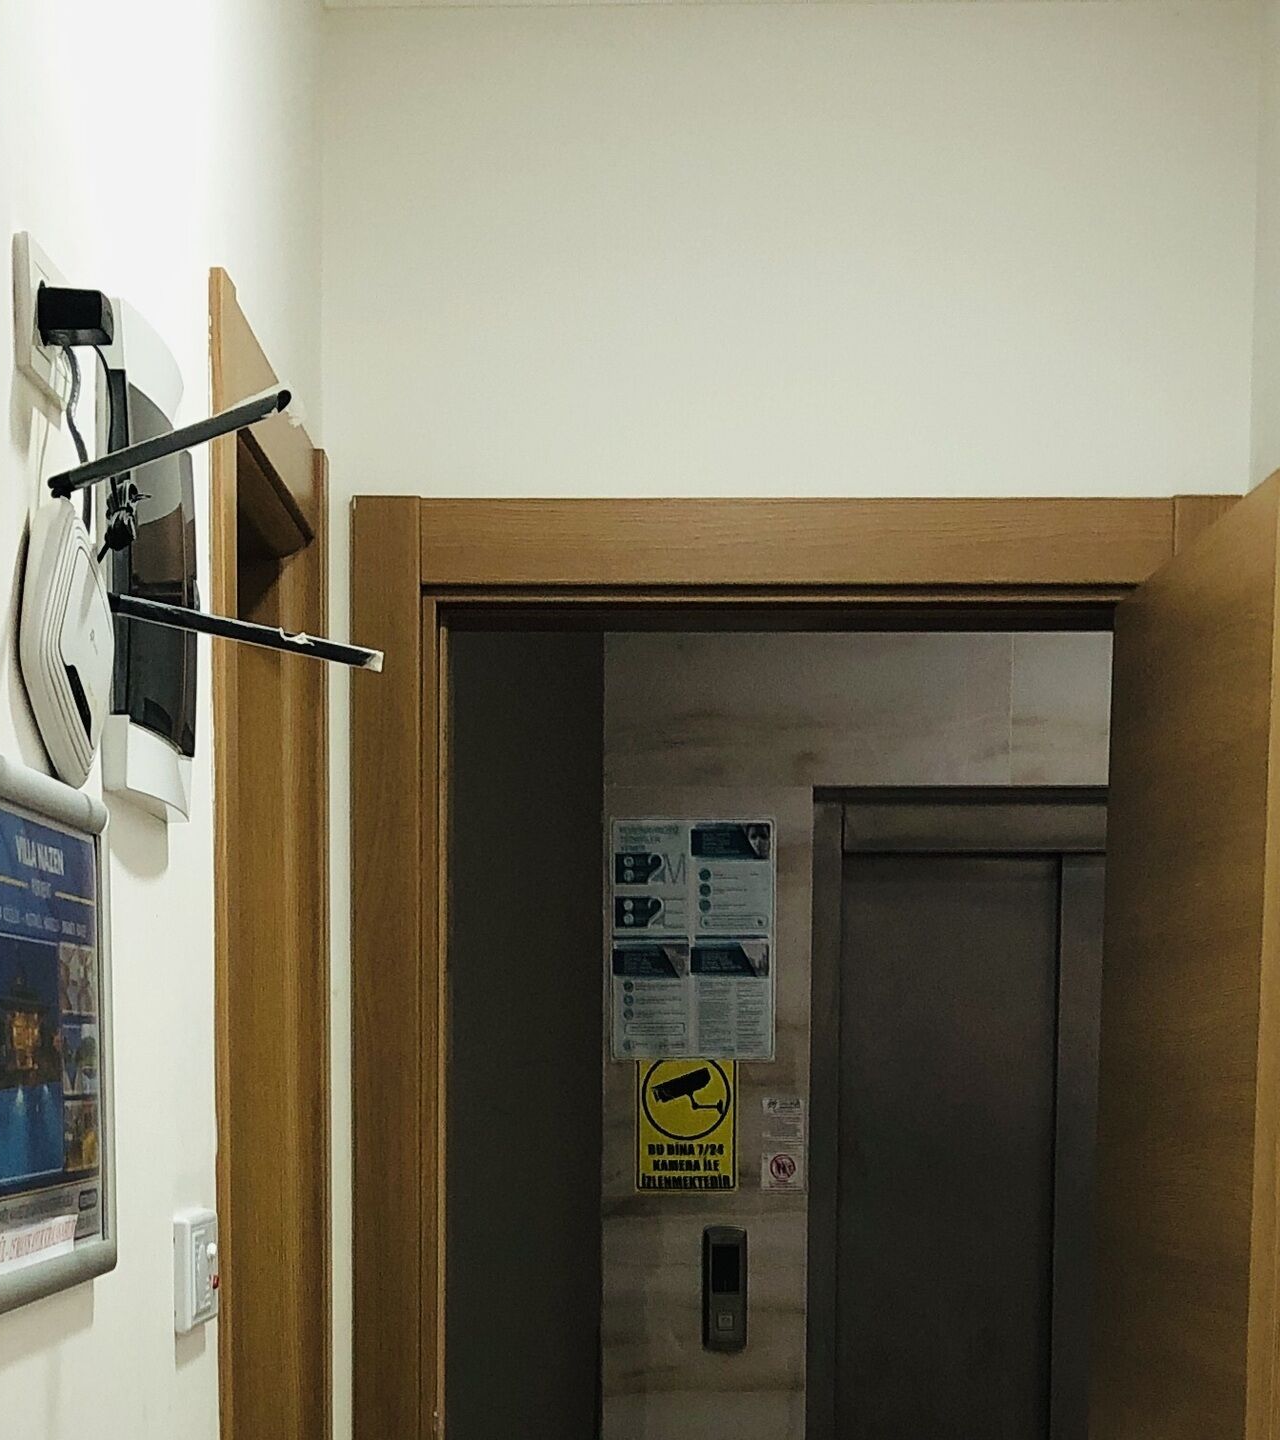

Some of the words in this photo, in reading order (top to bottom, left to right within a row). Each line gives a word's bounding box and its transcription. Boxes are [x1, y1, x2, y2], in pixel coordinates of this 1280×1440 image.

[648, 1143, 665, 1155] BU
[666, 1142, 695, 1155] BİNA
[697, 1143, 725, 1155] 7/24
[652, 1159, 700, 1171] KAMERA
[703, 1157, 720, 1171] İLE
[641, 1174, 730, 1189] İZLENMEKTEDİR
